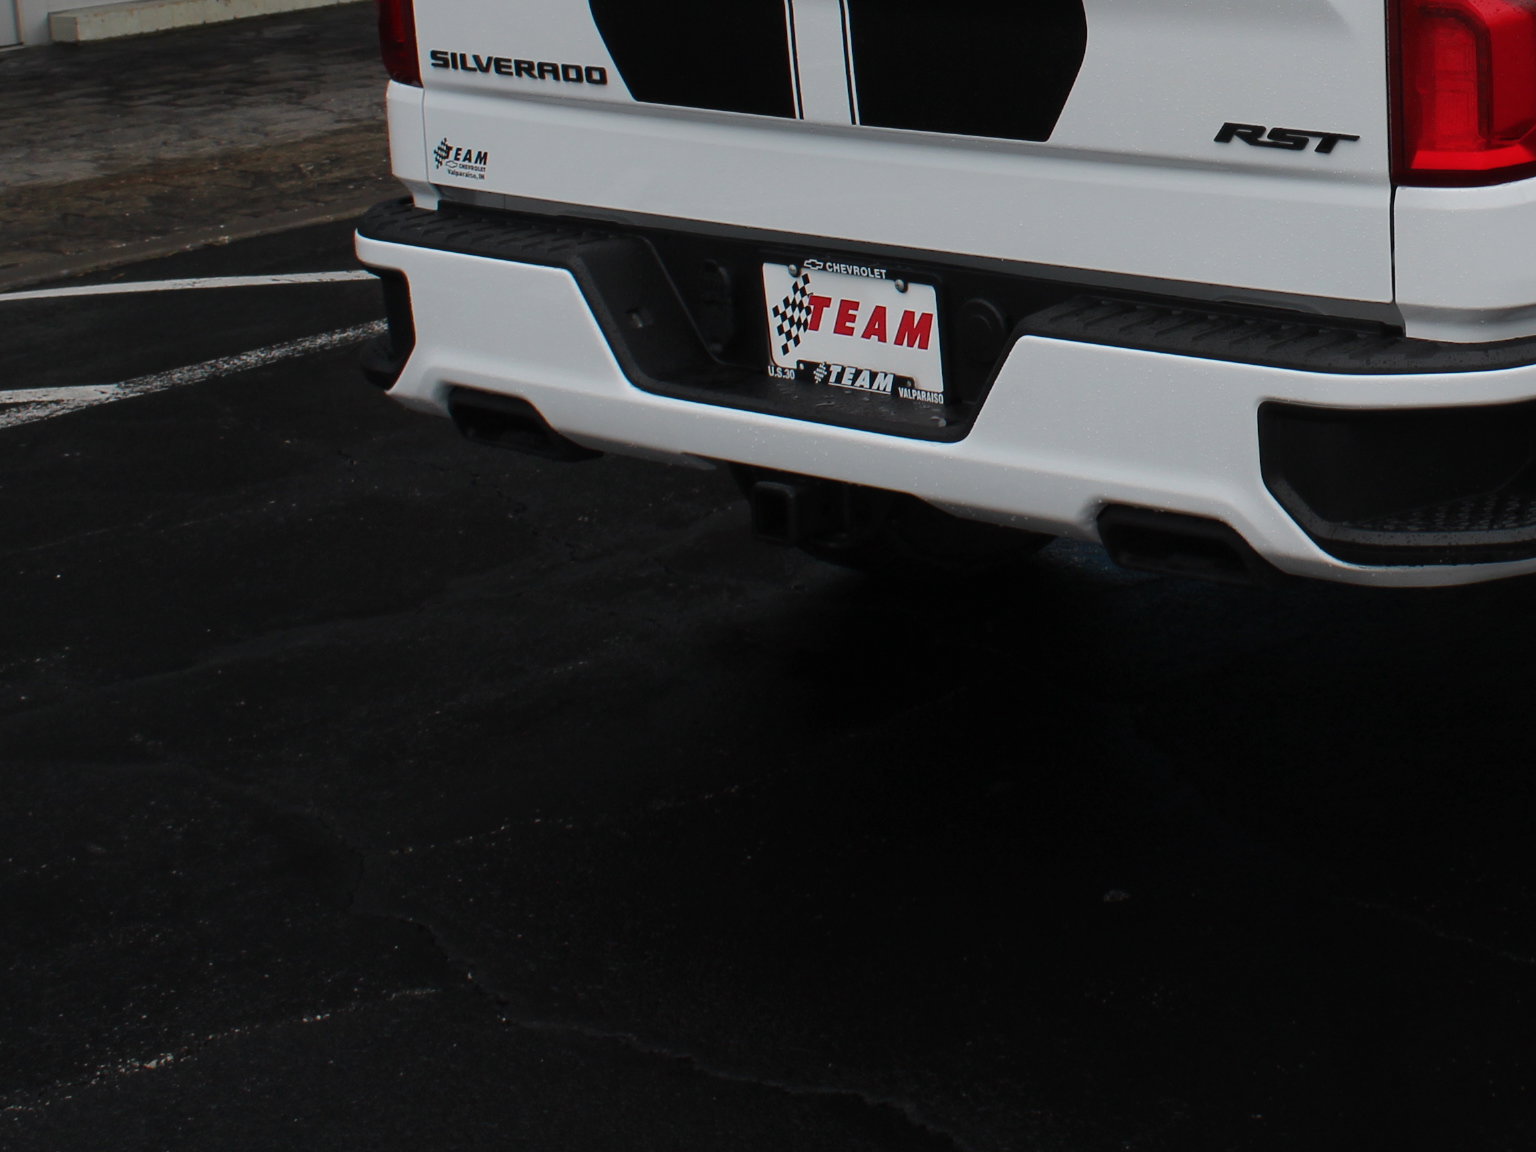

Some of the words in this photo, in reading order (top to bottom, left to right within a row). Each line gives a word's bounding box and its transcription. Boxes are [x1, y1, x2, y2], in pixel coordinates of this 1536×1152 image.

[430, 49, 608, 86] SILVERADO
[1213, 122, 1361, 154] RST
[459, 163, 485, 172] CHEVROLET
[825, 262, 887, 280] CHEVROLET
[808, 294, 933, 350] TEAM
[828, 364, 895, 392] TEAM
[898, 387, 944, 405] VALPARAISO
